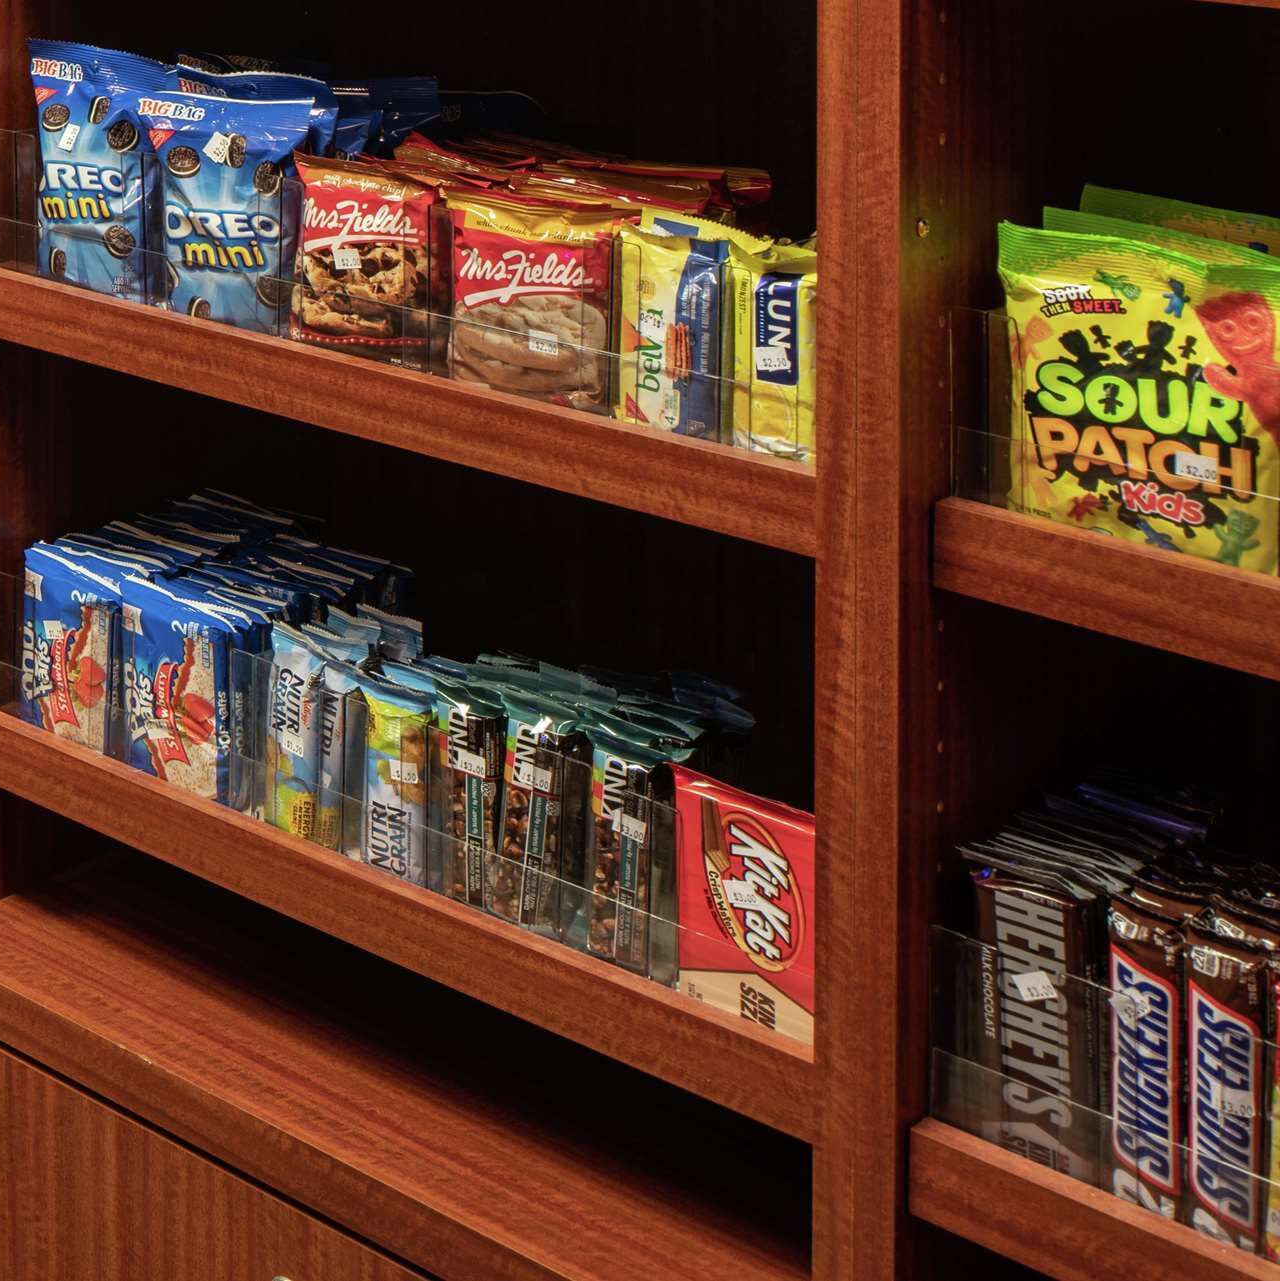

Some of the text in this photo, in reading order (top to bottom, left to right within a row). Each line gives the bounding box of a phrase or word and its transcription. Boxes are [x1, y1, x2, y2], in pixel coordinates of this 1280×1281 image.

[31, 58, 83, 81] BIG BAG
[138, 99, 205, 121] BIG BAG
[43, 192, 111, 219] mini
[166, 204, 279, 239] OREO
[342, 204, 416, 247] Fields
[185, 241, 264, 267] mini
[511, 253, 595, 301] Fields
[1042, 300, 1070, 317] THEN
[534, 340, 559, 354] $2.00
[763, 355, 788, 369] $2.50
[1037, 362, 1241, 443] SOUR
[1033, 418, 1251, 500] PATCH
[1185, 464, 1216, 481] $2.00
[1121, 481, 1205, 525] Kids
[285, 673, 306, 742] NUTRI
[603, 755, 627, 818] KIND
[370, 800, 389, 869] NUTRI
[390, 804, 407, 876] GRAIN
[982, 973, 997, 1040] CHOCOLATE
[1221, 1102, 1253, 1116] $3.00
